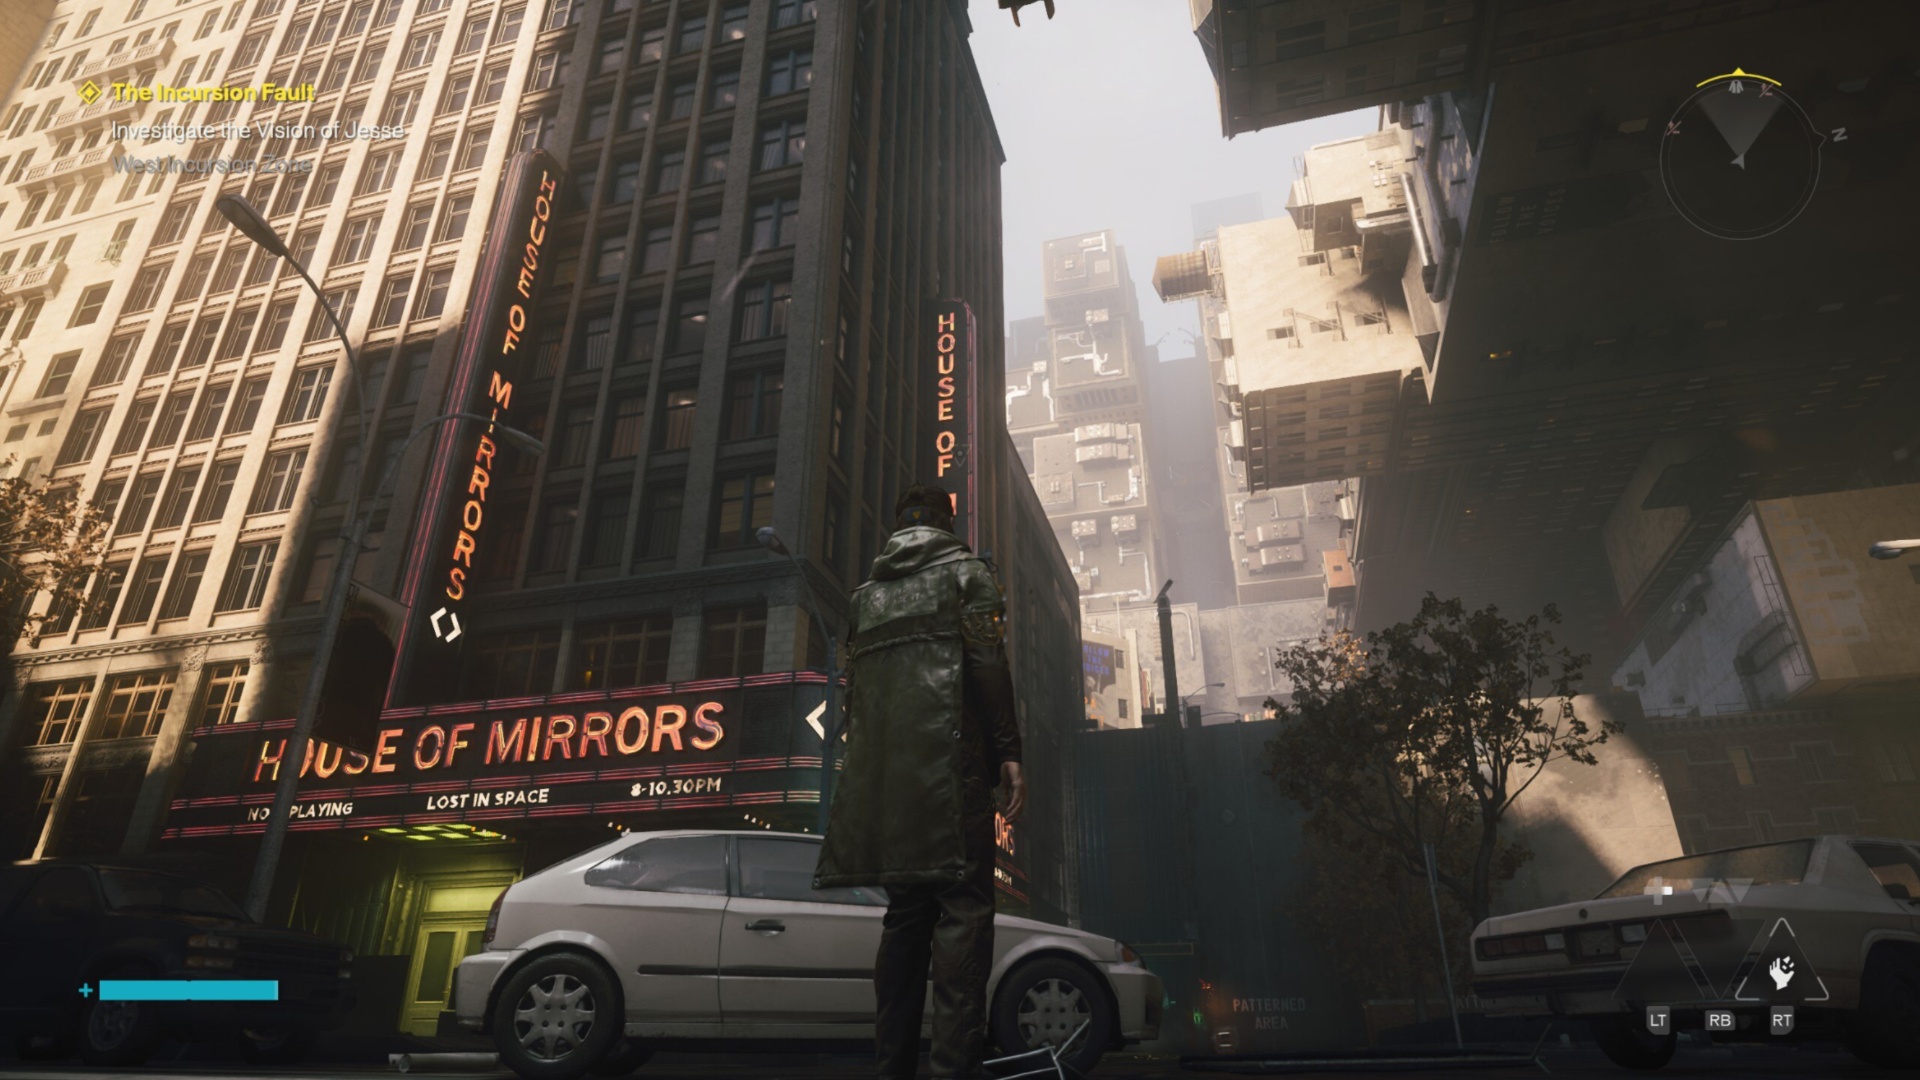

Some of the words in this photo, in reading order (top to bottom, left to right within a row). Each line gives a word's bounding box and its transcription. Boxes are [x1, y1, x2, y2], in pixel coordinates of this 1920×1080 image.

[518, 170, 556, 299] HOUSE
[502, 304, 526, 356] OF
[936, 312, 956, 422] HOUSE
[935, 431, 956, 478] OF
[446, 371, 511, 601] MIRRORS
[413, 722, 475, 770] OF
[484, 702, 724, 765] MIRRORS
[289, 802, 353, 818] PLAYING
[426, 793, 470, 810] LOST
[473, 792, 489, 807] IN
[495, 788, 549, 805] SPACE
[1232, 998, 1306, 1012] PATTERNED
[1255, 1016, 1288, 1030] AREA
